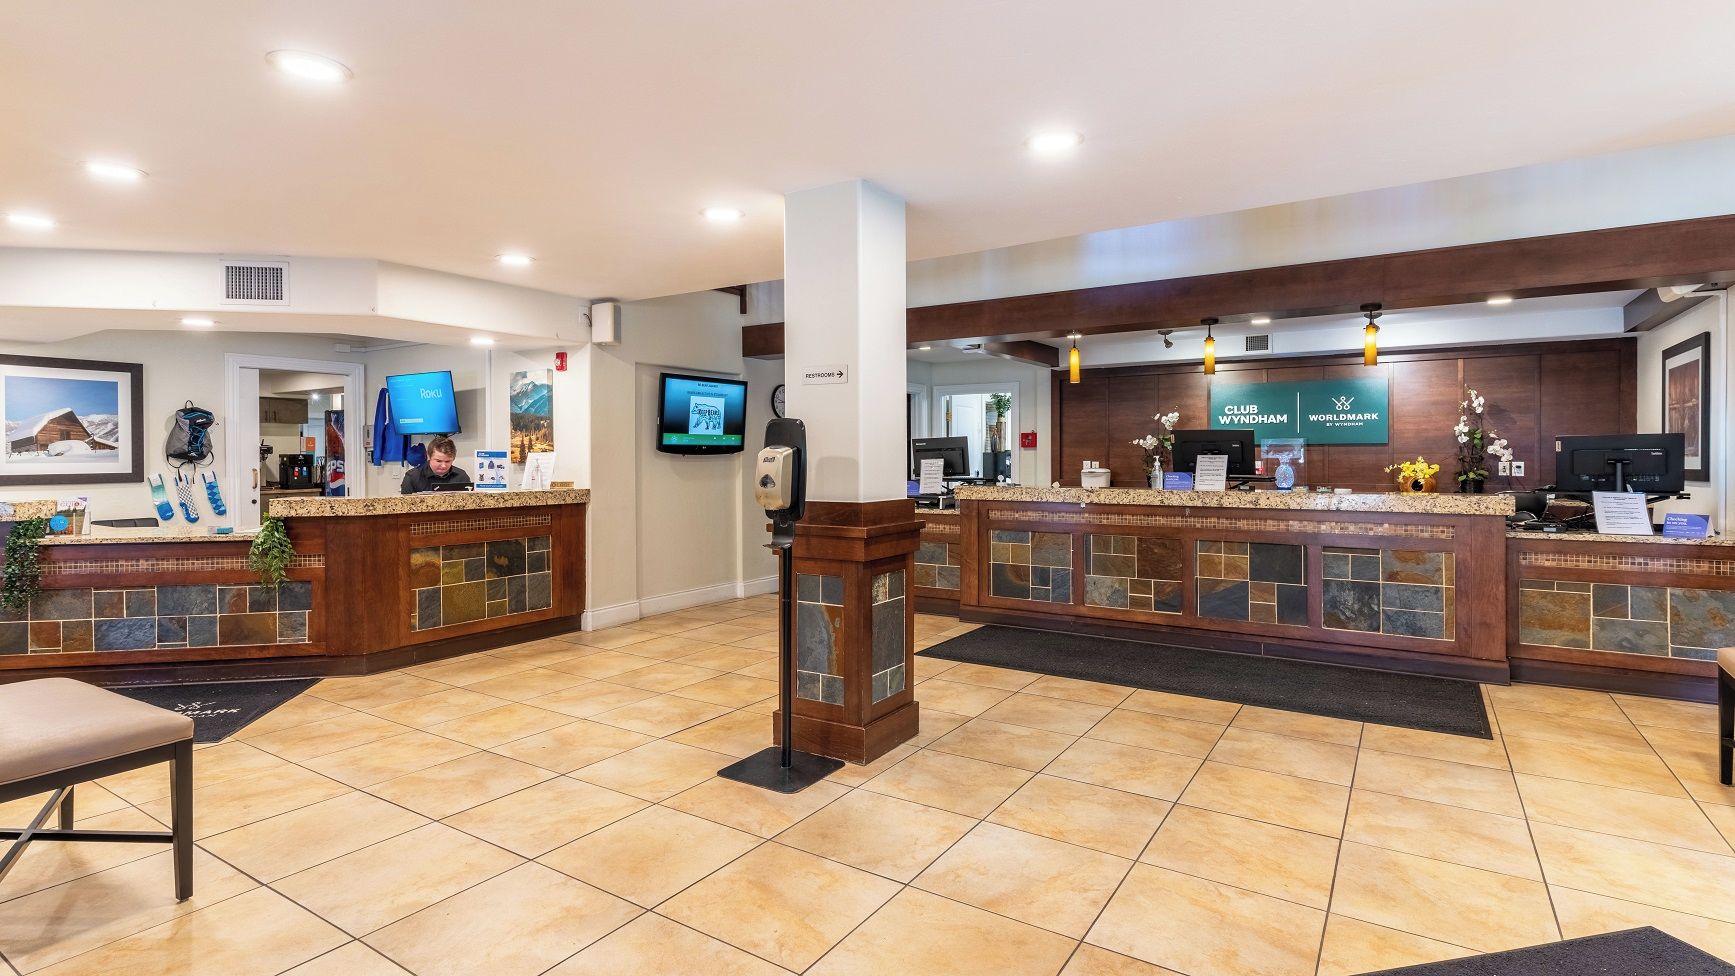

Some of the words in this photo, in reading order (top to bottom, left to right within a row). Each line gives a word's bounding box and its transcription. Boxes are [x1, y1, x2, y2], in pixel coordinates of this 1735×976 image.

[1224, 404, 1258, 415] CLUB
[1218, 414, 1288, 425] WYNDHAM
[1309, 413, 1379, 422] WORLDMARK
[327, 460, 344, 475] EPS
